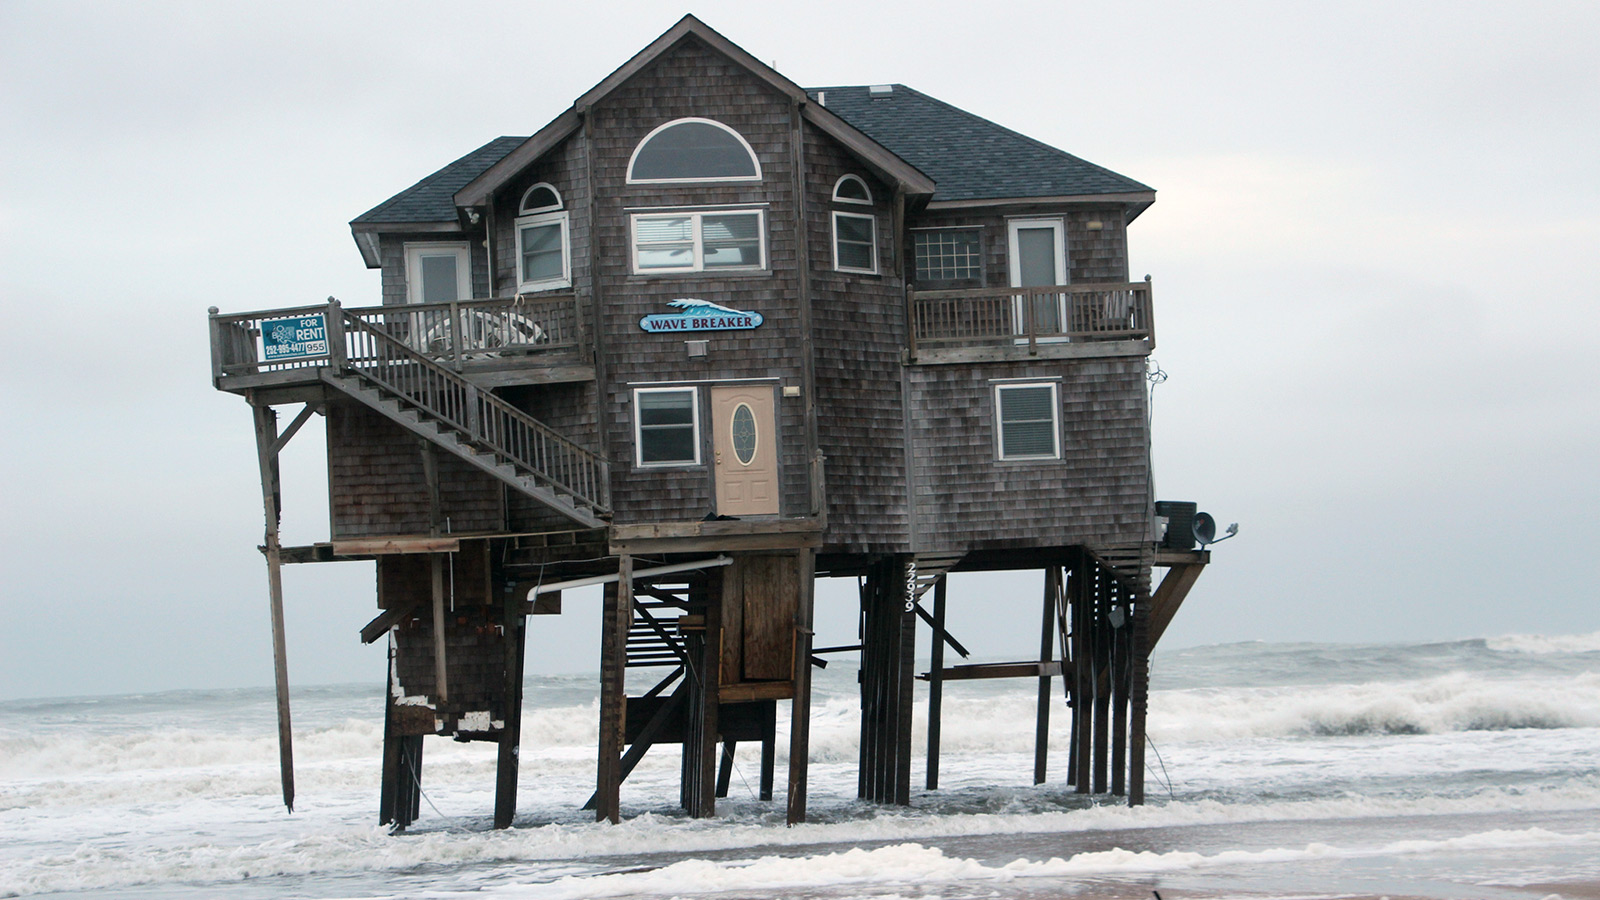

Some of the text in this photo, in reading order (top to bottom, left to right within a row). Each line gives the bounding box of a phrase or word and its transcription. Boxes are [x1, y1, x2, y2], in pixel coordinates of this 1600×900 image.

[300, 318, 318, 328] FOR
[650, 317, 753, 330] WAVE BREAKER
[296, 327, 323, 341] RENT
[306, 343, 325, 352] 955
[905, 562, 917, 613] 22939
